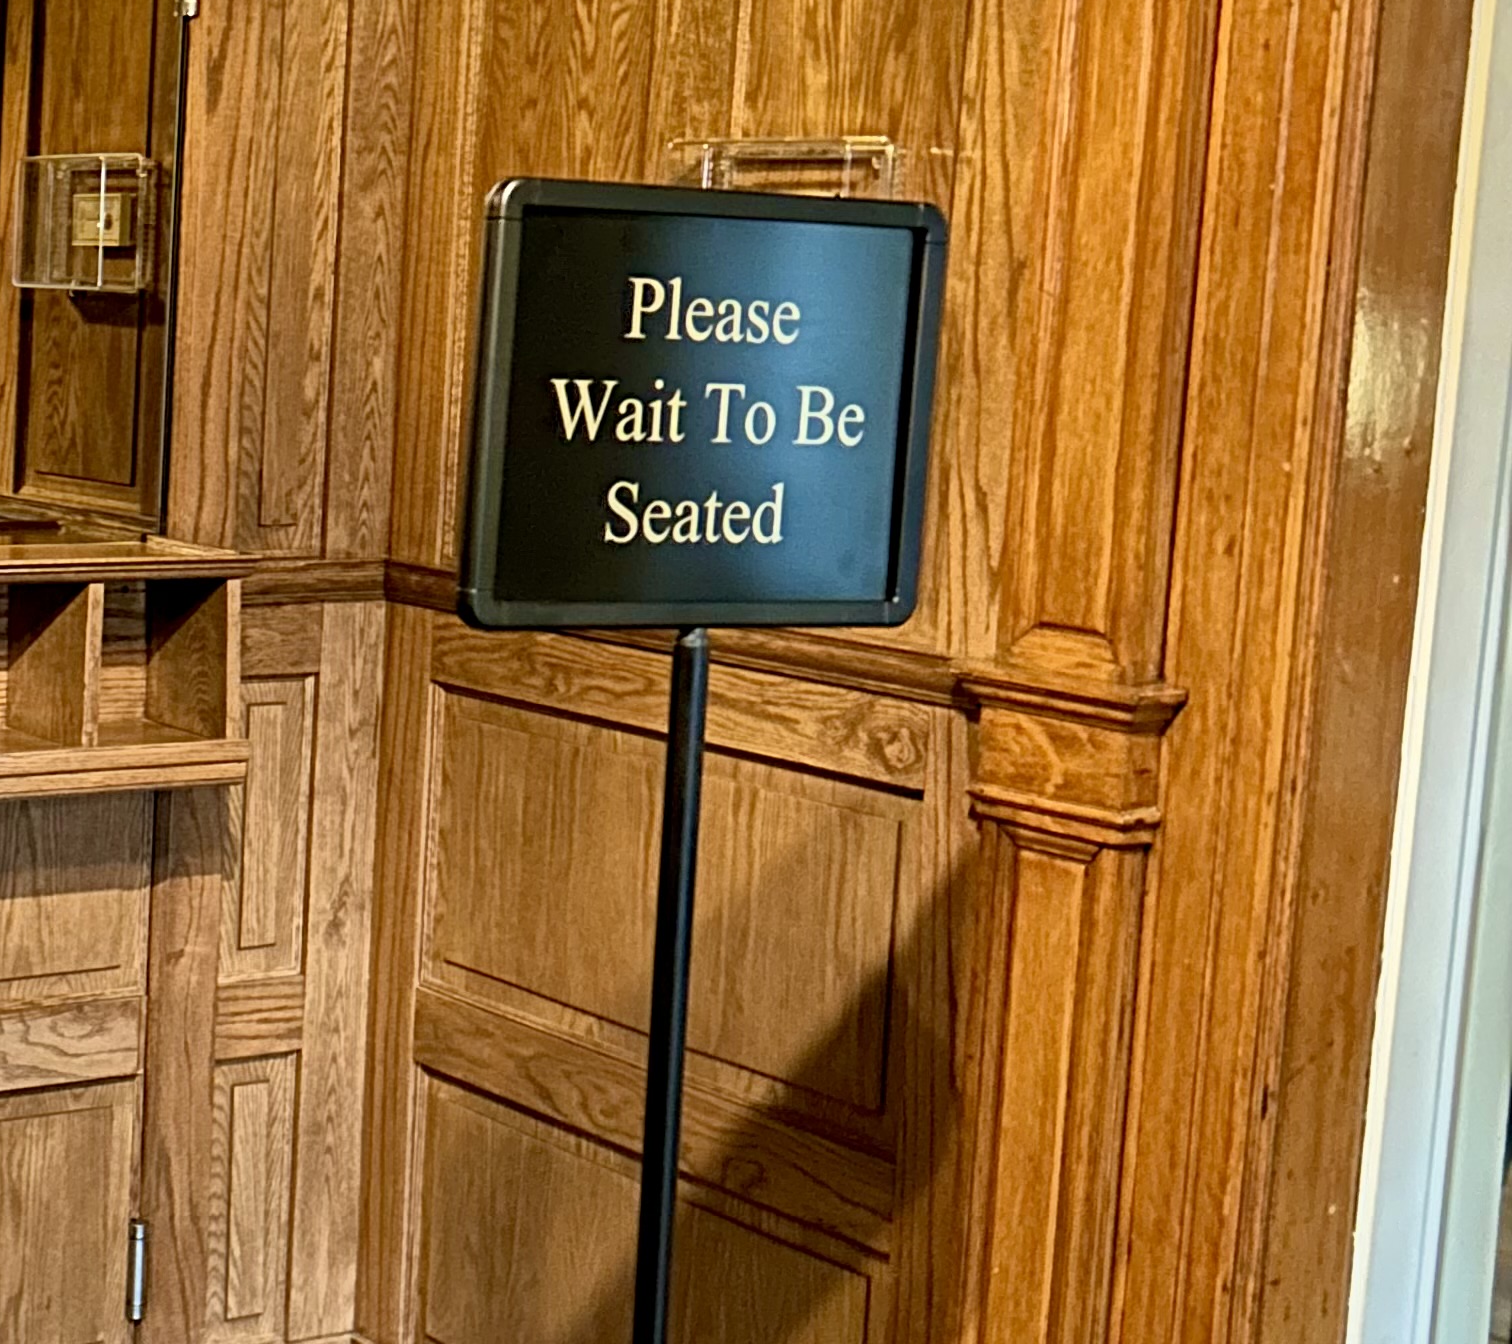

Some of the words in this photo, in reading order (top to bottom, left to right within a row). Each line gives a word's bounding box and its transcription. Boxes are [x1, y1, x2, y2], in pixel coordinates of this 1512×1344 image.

[623, 276, 801, 344] Please
[550, 378, 687, 443] Wait
[704, 382, 777, 444] To
[792, 385, 866, 447] Be
[604, 481, 785, 545] Seated
